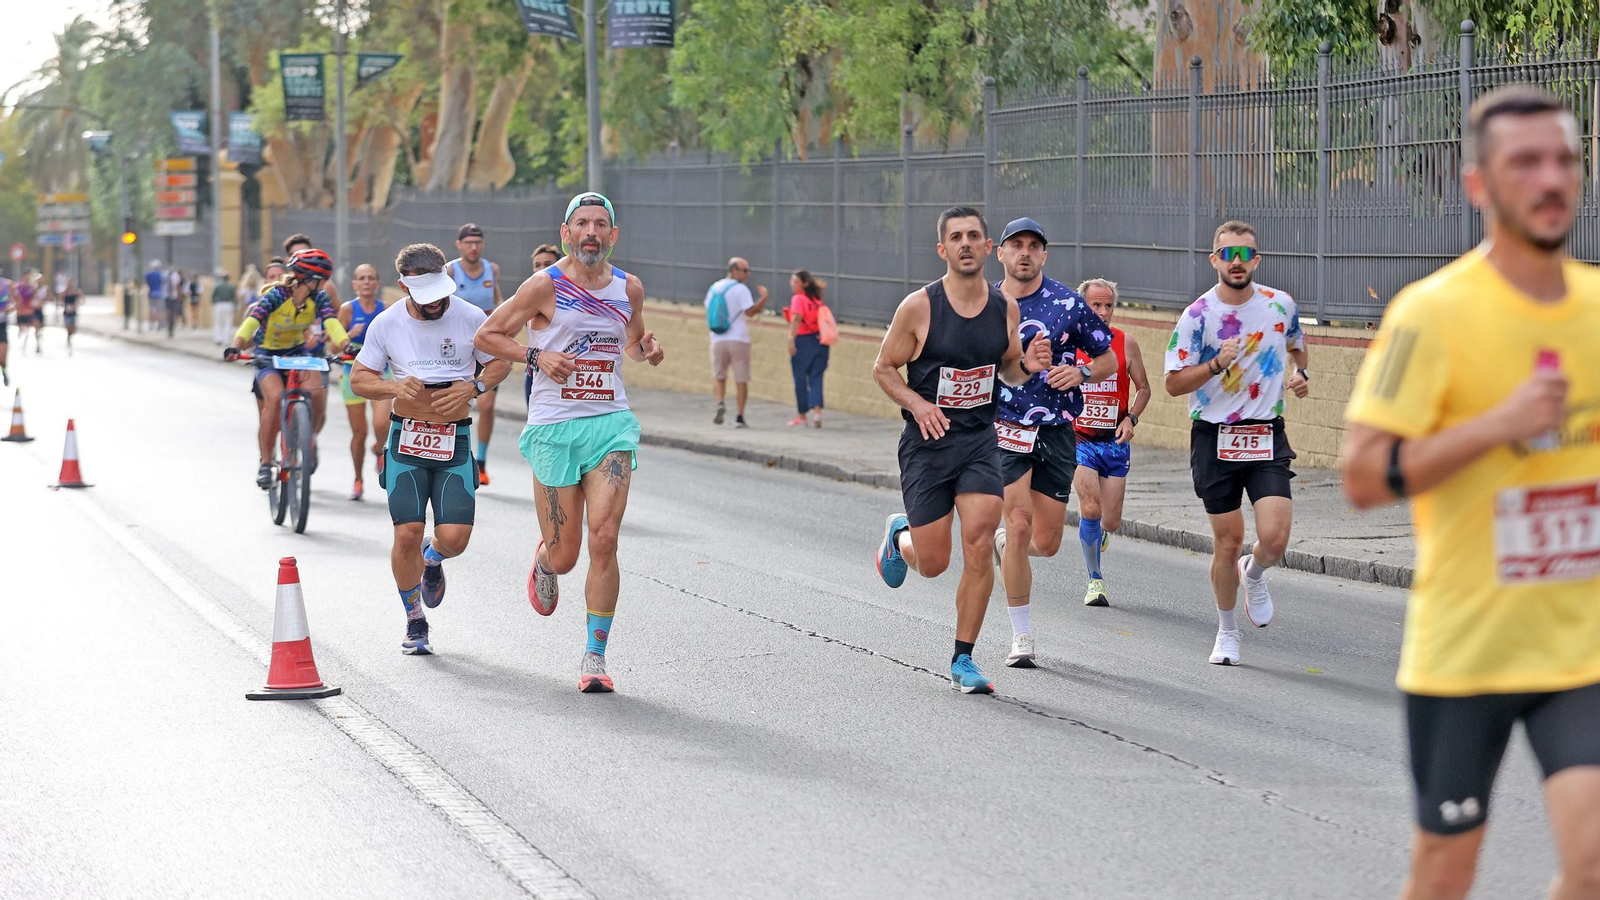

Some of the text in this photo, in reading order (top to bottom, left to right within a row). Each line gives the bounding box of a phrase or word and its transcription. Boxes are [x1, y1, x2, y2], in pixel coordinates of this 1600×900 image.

[575, 373, 603, 388] 546
[952, 381, 981, 396] 229
[1086, 406, 1109, 418] 532
[412, 434, 441, 449] 402
[1231, 435, 1259, 449] 415
